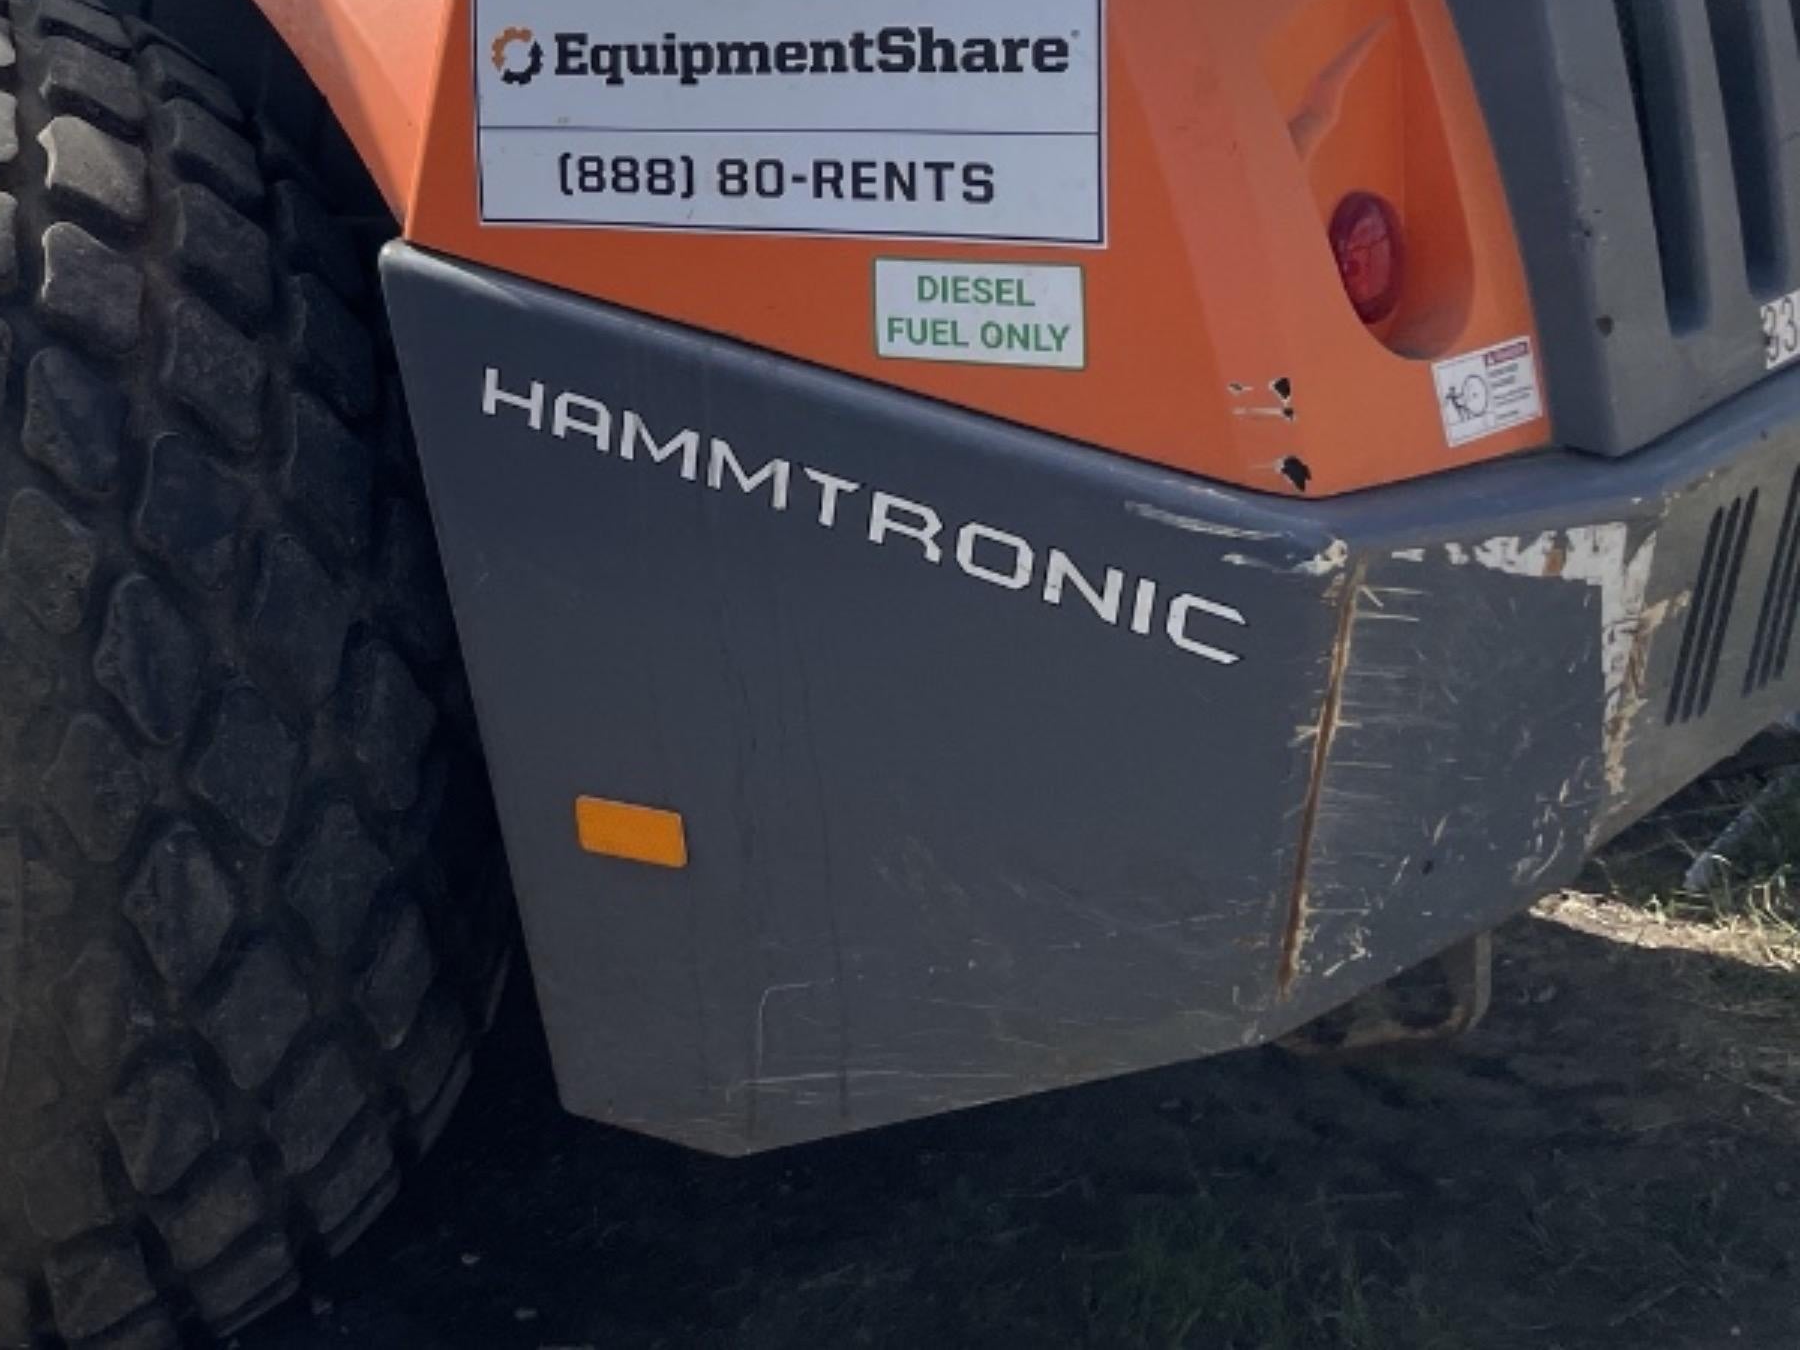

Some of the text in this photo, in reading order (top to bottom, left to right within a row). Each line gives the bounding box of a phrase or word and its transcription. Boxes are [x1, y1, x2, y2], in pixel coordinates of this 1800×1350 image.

[554, 26, 1070, 86] EquipmentShare
[559, 151, 996, 205] (888) 80-RENTS
[916, 275, 1036, 308] DIESEL
[886, 317, 1071, 353] FUEL ONLY
[481, 366, 1247, 665] HAMMTRONIC
